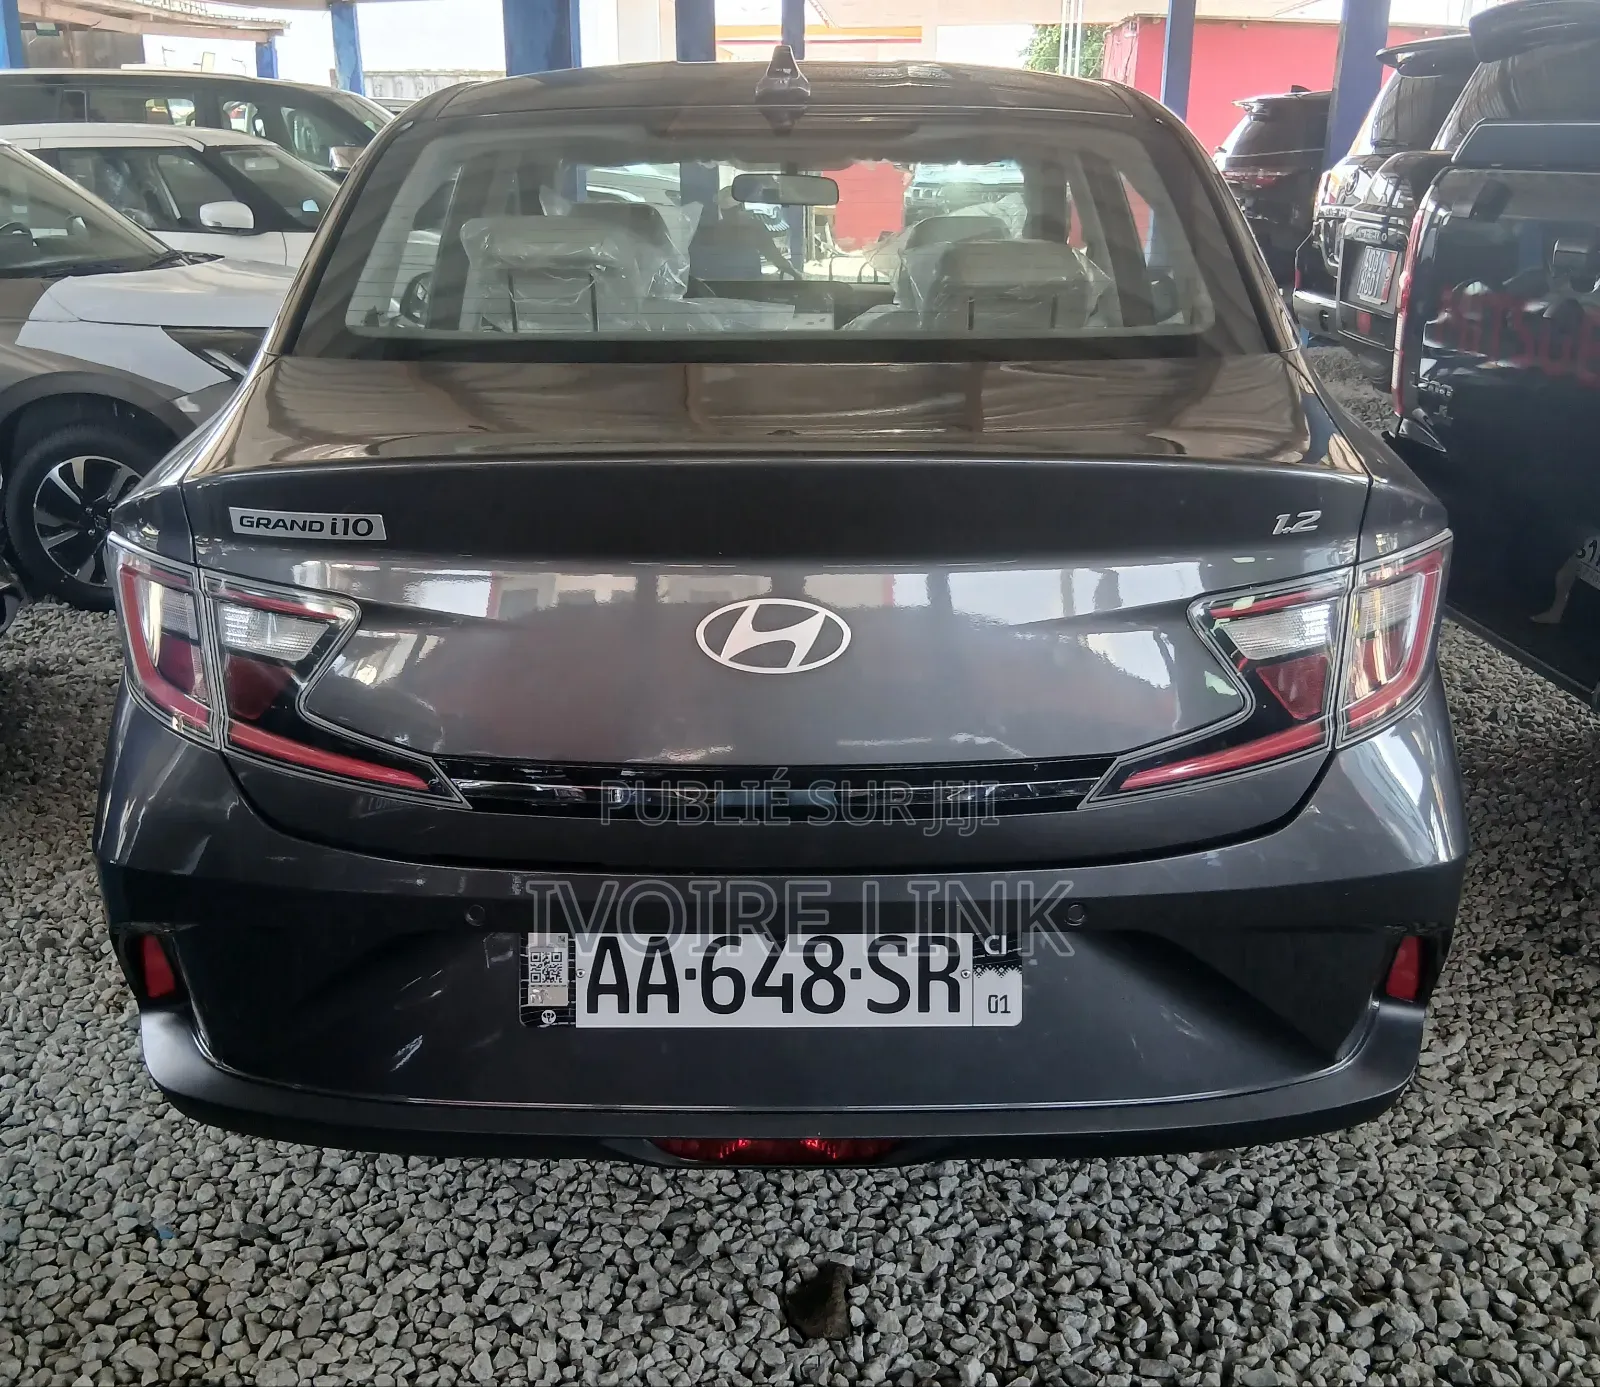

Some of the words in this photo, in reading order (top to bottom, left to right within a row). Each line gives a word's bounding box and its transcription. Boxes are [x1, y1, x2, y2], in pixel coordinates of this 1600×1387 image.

[239, 515, 325, 533] GRAND
[330, 517, 374, 537] i10
[1272, 510, 1322, 535] 1.2
[988, 994, 1011, 1014] 01
